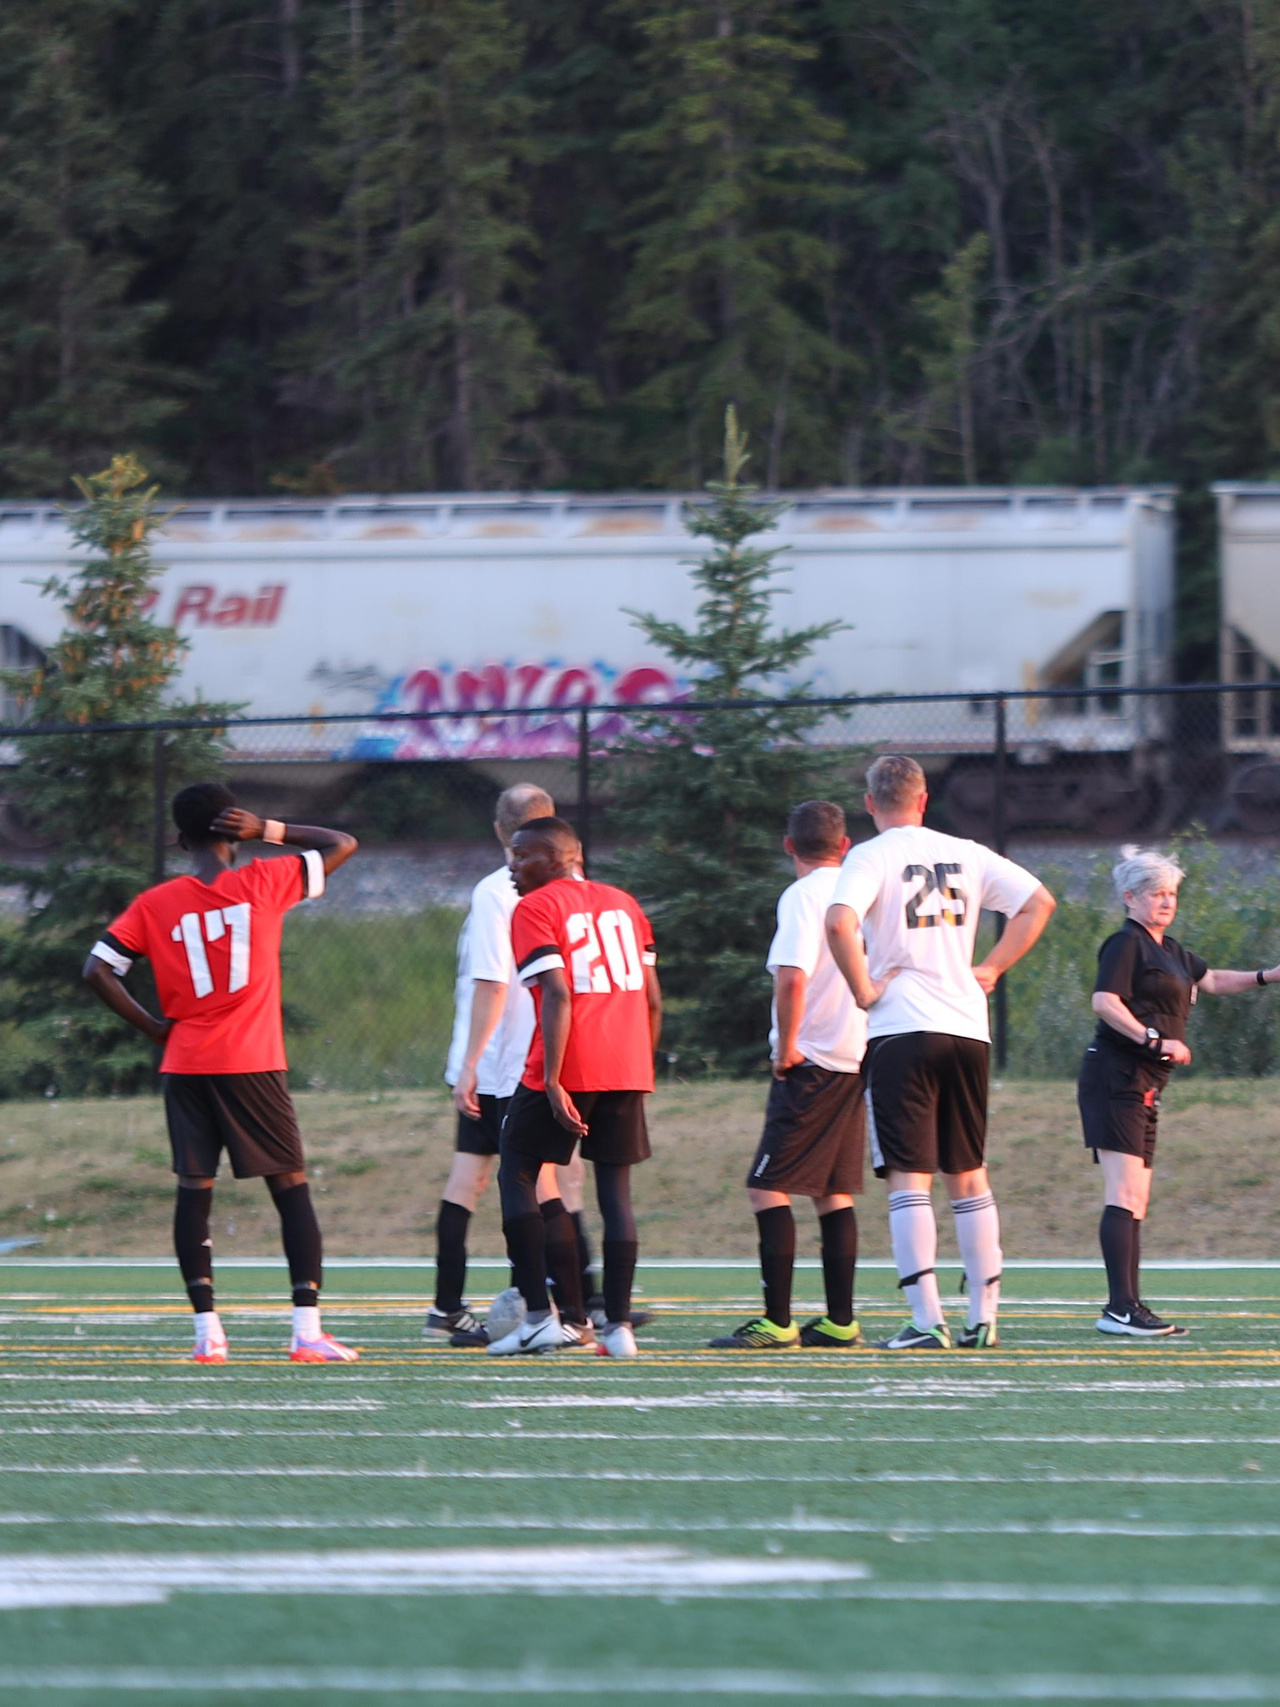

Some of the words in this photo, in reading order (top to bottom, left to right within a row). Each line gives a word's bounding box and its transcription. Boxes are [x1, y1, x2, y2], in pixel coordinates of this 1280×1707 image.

[173, 583, 287, 628] Rail
[902, 863, 967, 929] 25
[171, 902, 251, 999] 17
[565, 909, 644, 994] 20
